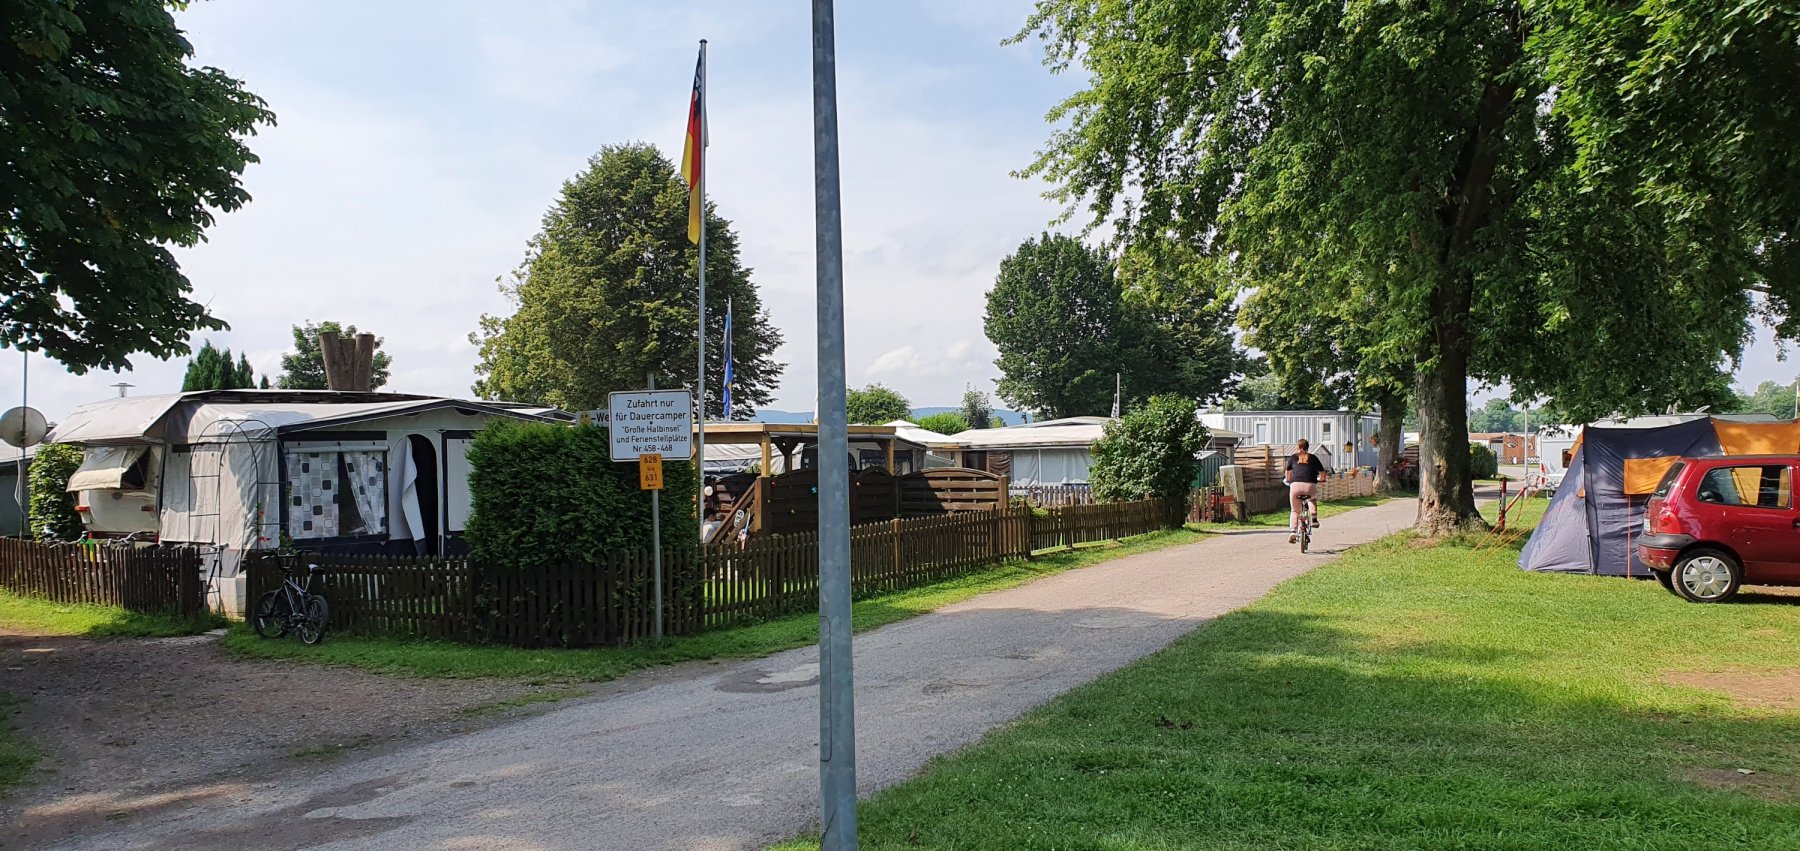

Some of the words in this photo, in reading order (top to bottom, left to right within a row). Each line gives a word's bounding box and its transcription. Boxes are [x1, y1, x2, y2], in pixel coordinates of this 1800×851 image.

[627, 400, 658, 408] Zufahrt
[615, 412, 628, 421] für
[629, 411, 687, 421] Dauercamper
[631, 434, 688, 444] Ferienstellplätze
[644, 456, 658, 464] 628
